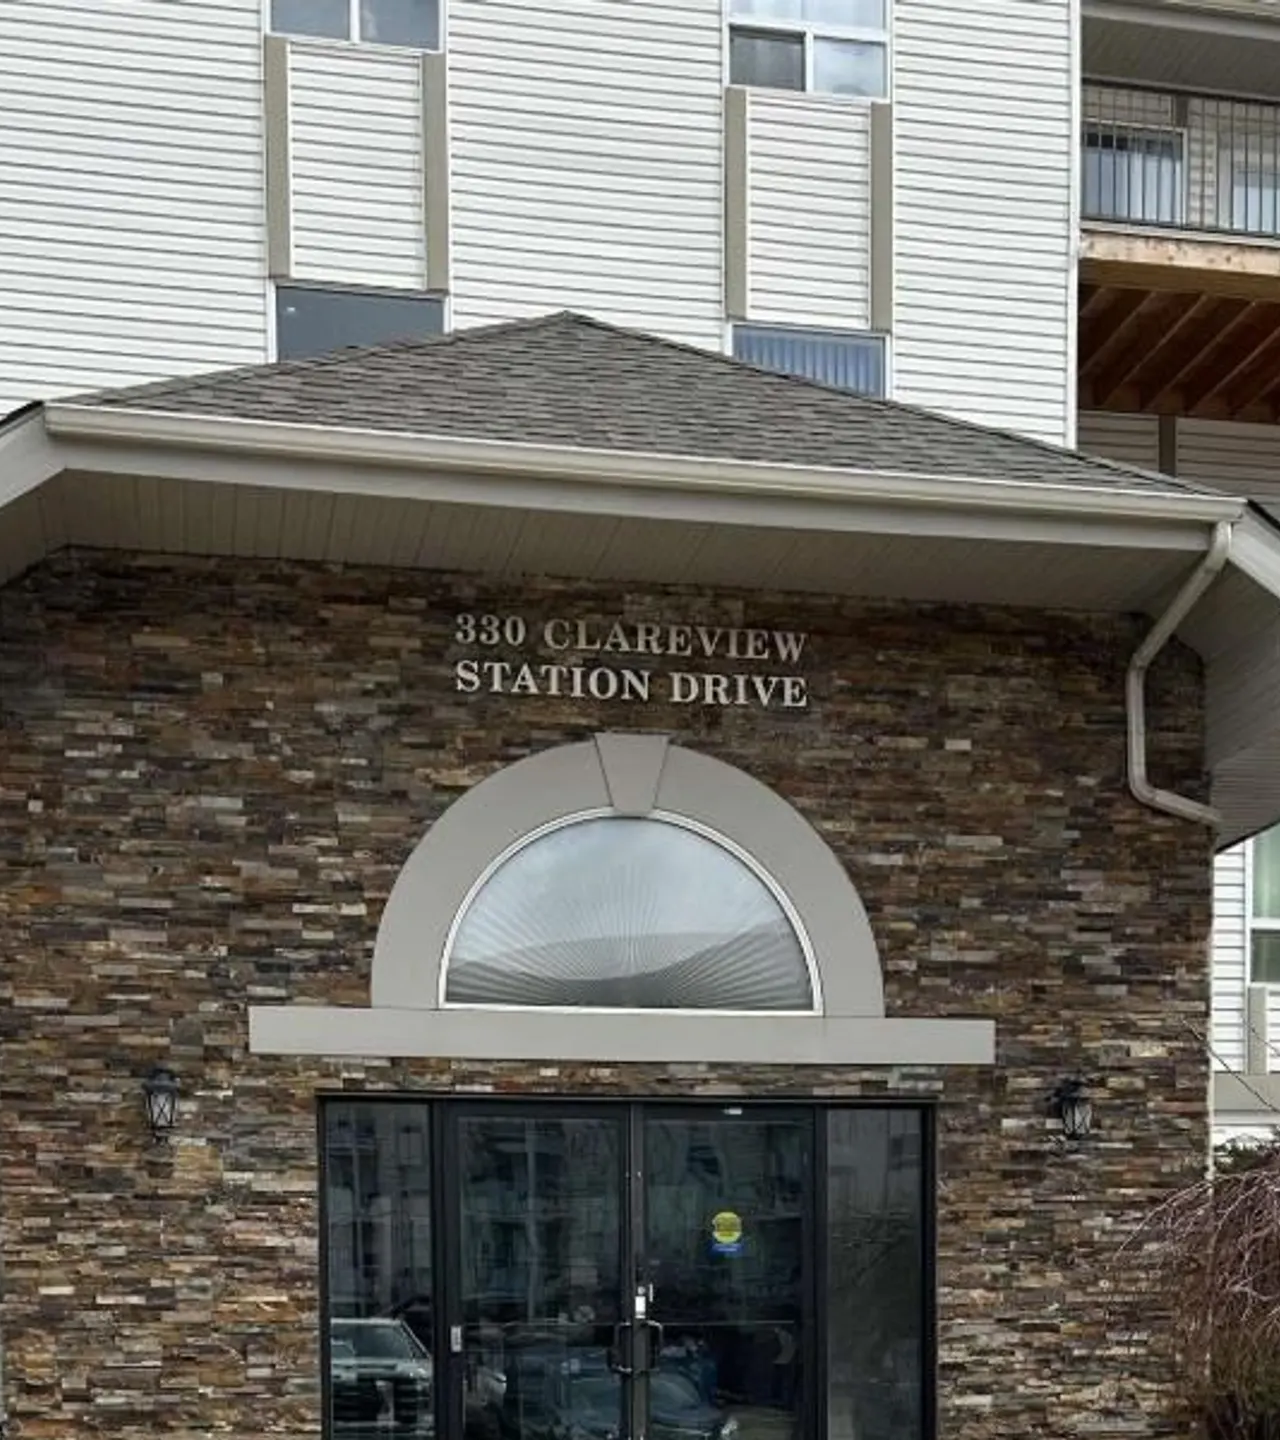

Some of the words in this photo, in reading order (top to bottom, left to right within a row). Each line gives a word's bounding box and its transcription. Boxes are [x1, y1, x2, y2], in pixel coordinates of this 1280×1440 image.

[455, 613, 527, 647] 330
[544, 617, 808, 664] CLAREVIEW
[455, 660, 651, 701] STATION
[669, 670, 808, 708] DRIVE
